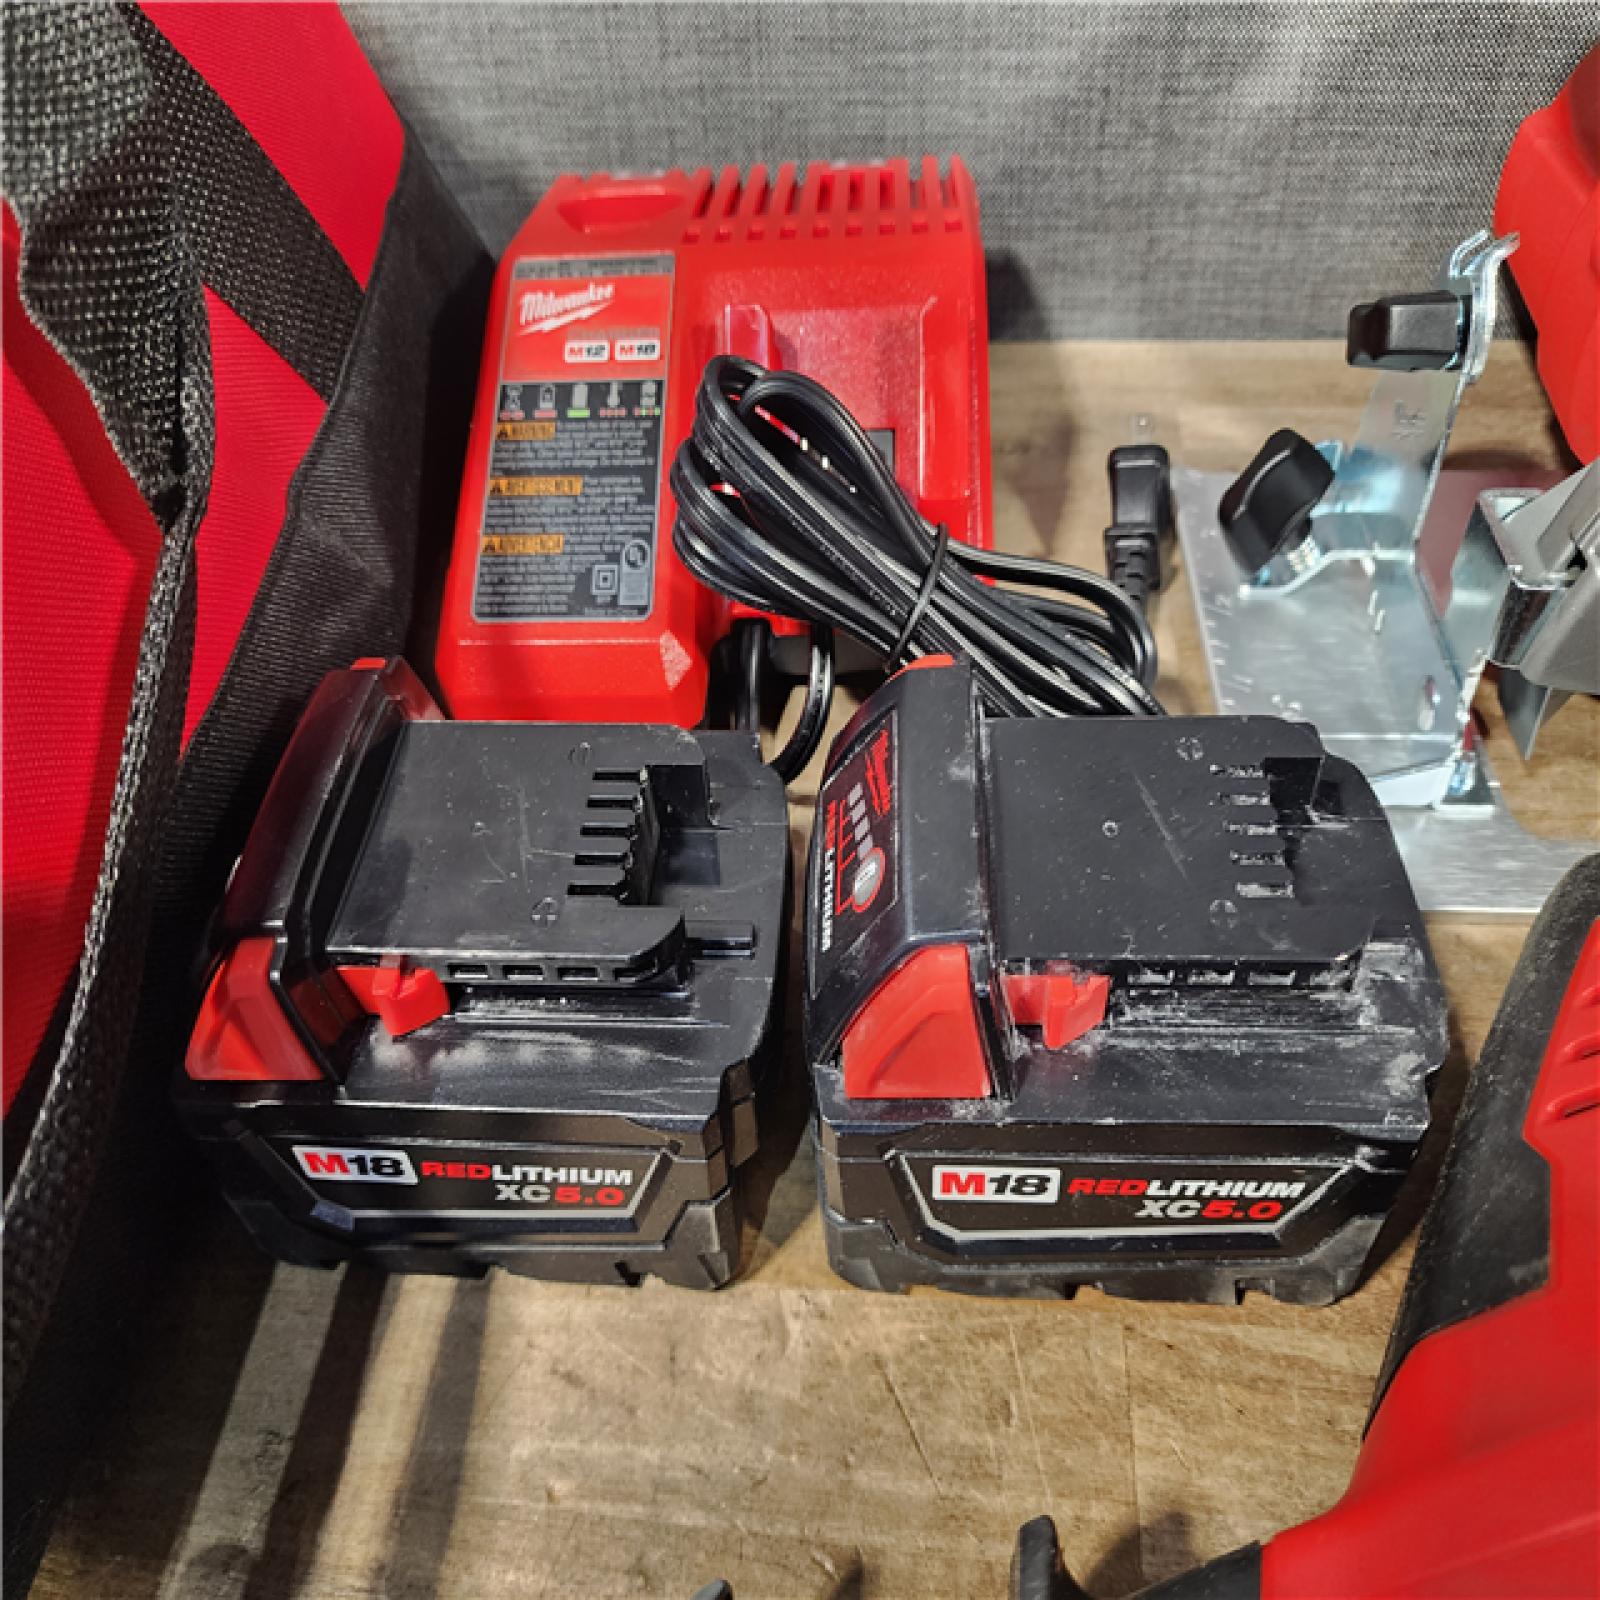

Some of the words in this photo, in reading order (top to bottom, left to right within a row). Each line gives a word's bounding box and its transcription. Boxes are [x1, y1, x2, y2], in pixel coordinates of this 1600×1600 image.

[303, 1151, 405, 1176] M18
[422, 1161, 634, 1186] REDLITHIUM
[940, 1171, 1052, 1197] M18
[1067, 1178, 1306, 1199] REDLITHIUM
